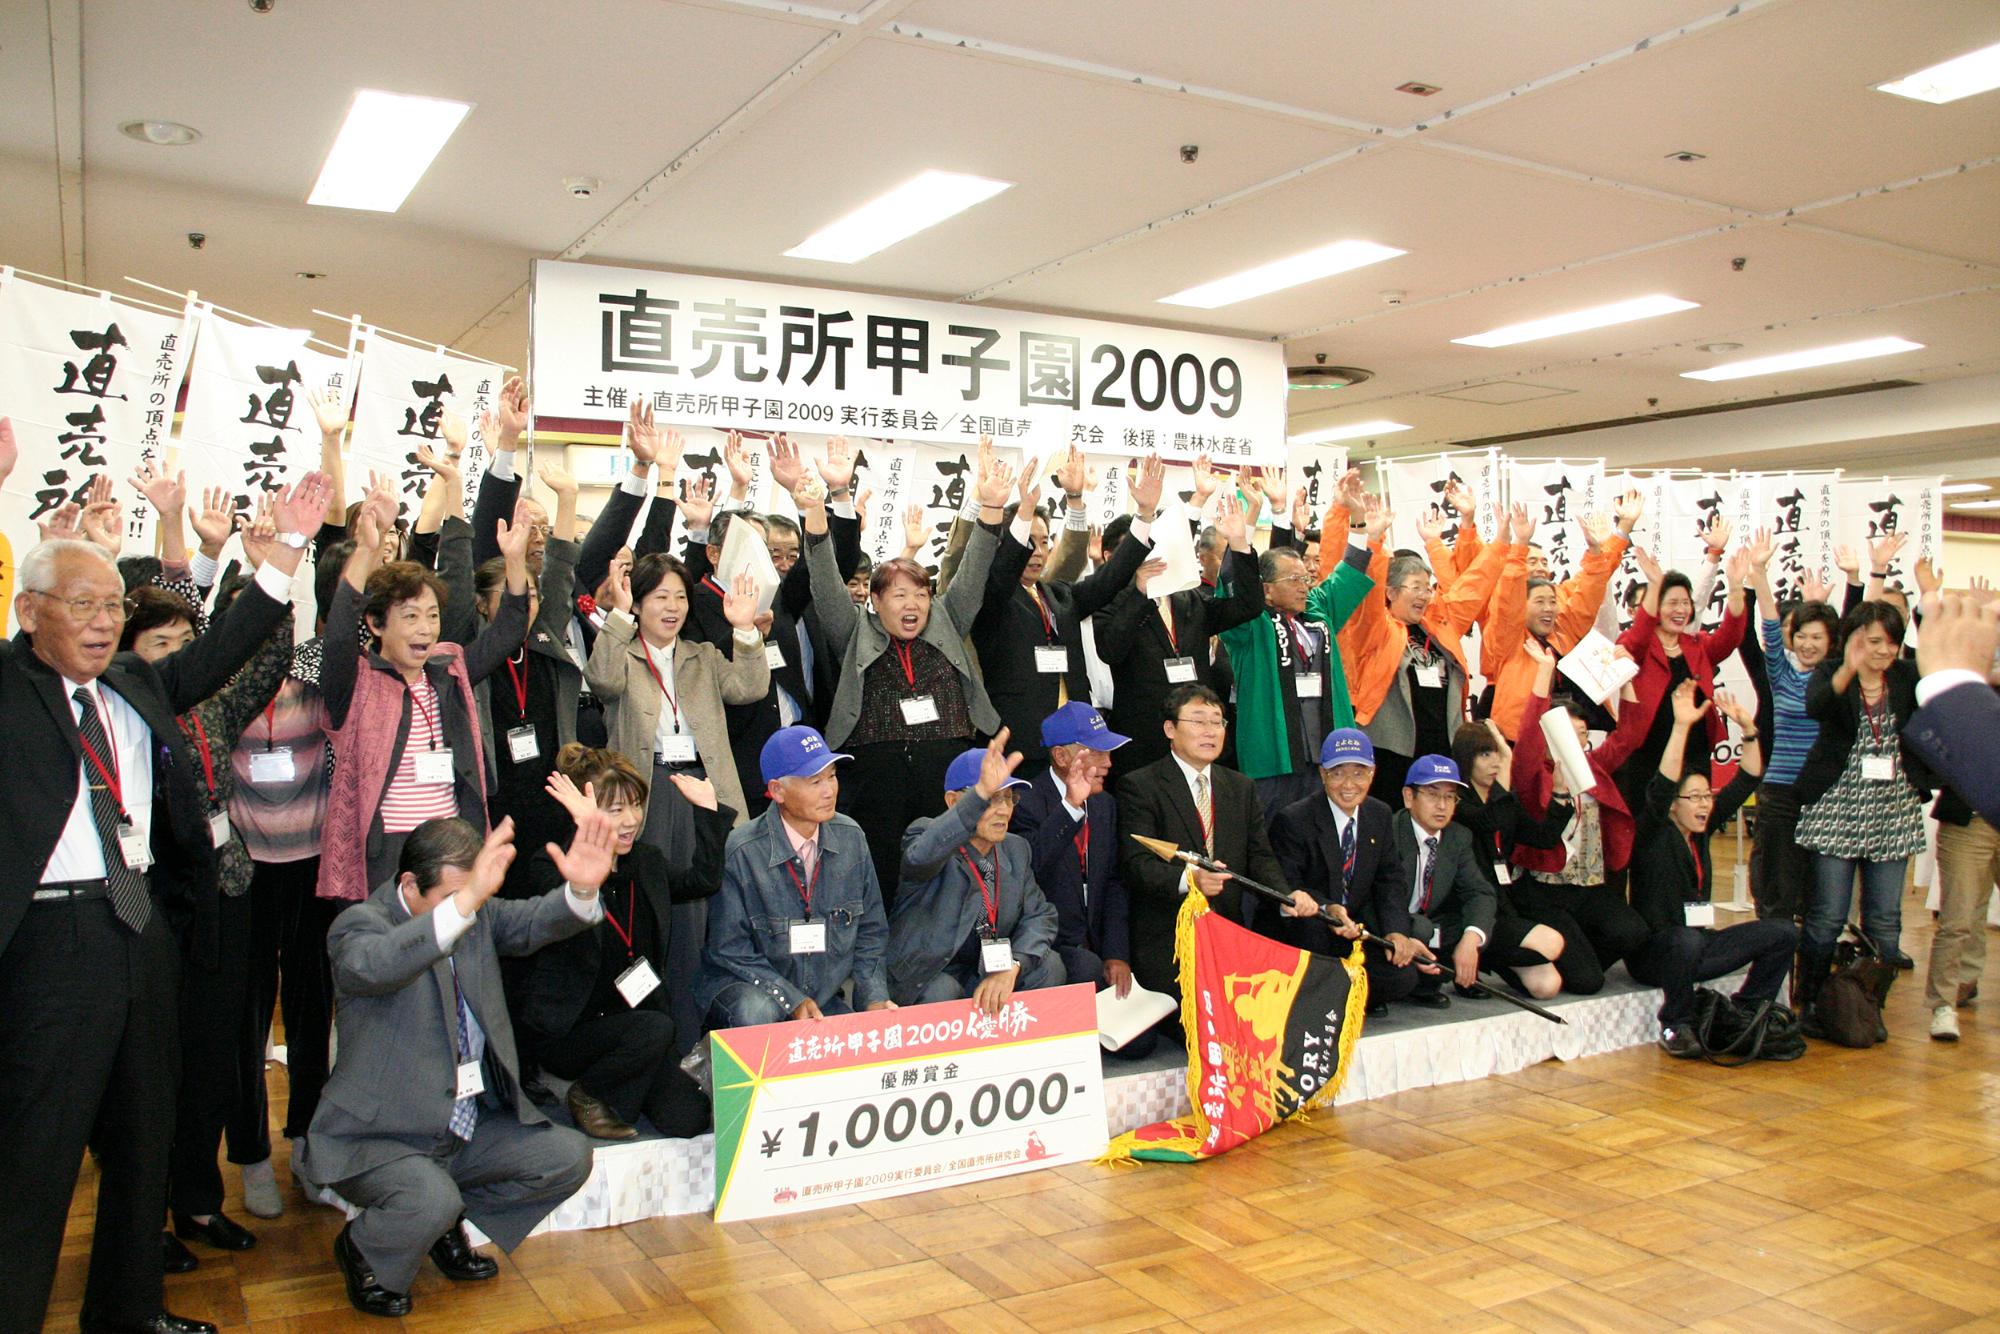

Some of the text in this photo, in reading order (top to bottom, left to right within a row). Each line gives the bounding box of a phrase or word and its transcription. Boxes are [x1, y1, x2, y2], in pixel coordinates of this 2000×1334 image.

[599, 289, 1242, 418] 直売所甲子園2009
[129, 333, 178, 538] 直売所の頂点をせ!!
[1123, 428, 1252, 456] 後援：農林水産省
[881, 1062, 960, 1090] 優勝賞金
